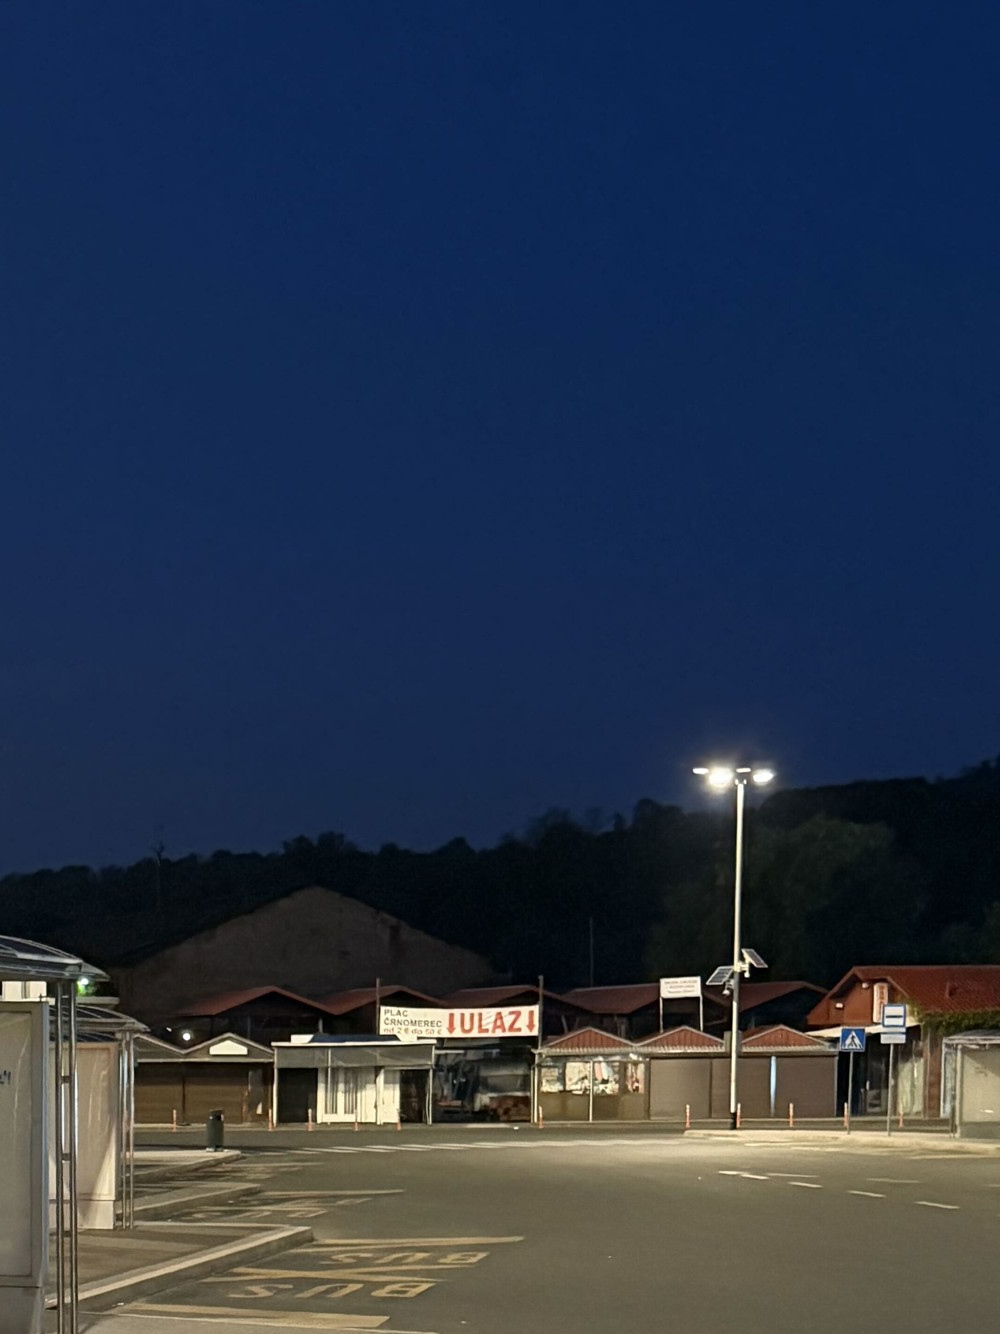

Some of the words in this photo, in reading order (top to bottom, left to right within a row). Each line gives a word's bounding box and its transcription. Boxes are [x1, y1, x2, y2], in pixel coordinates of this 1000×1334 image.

[384, 1009, 408, 1017] PLAC
[460, 1010, 523, 1034] ULAZ
[320, 1251, 491, 1265] BUS
[228, 1282, 438, 1298] BUS
